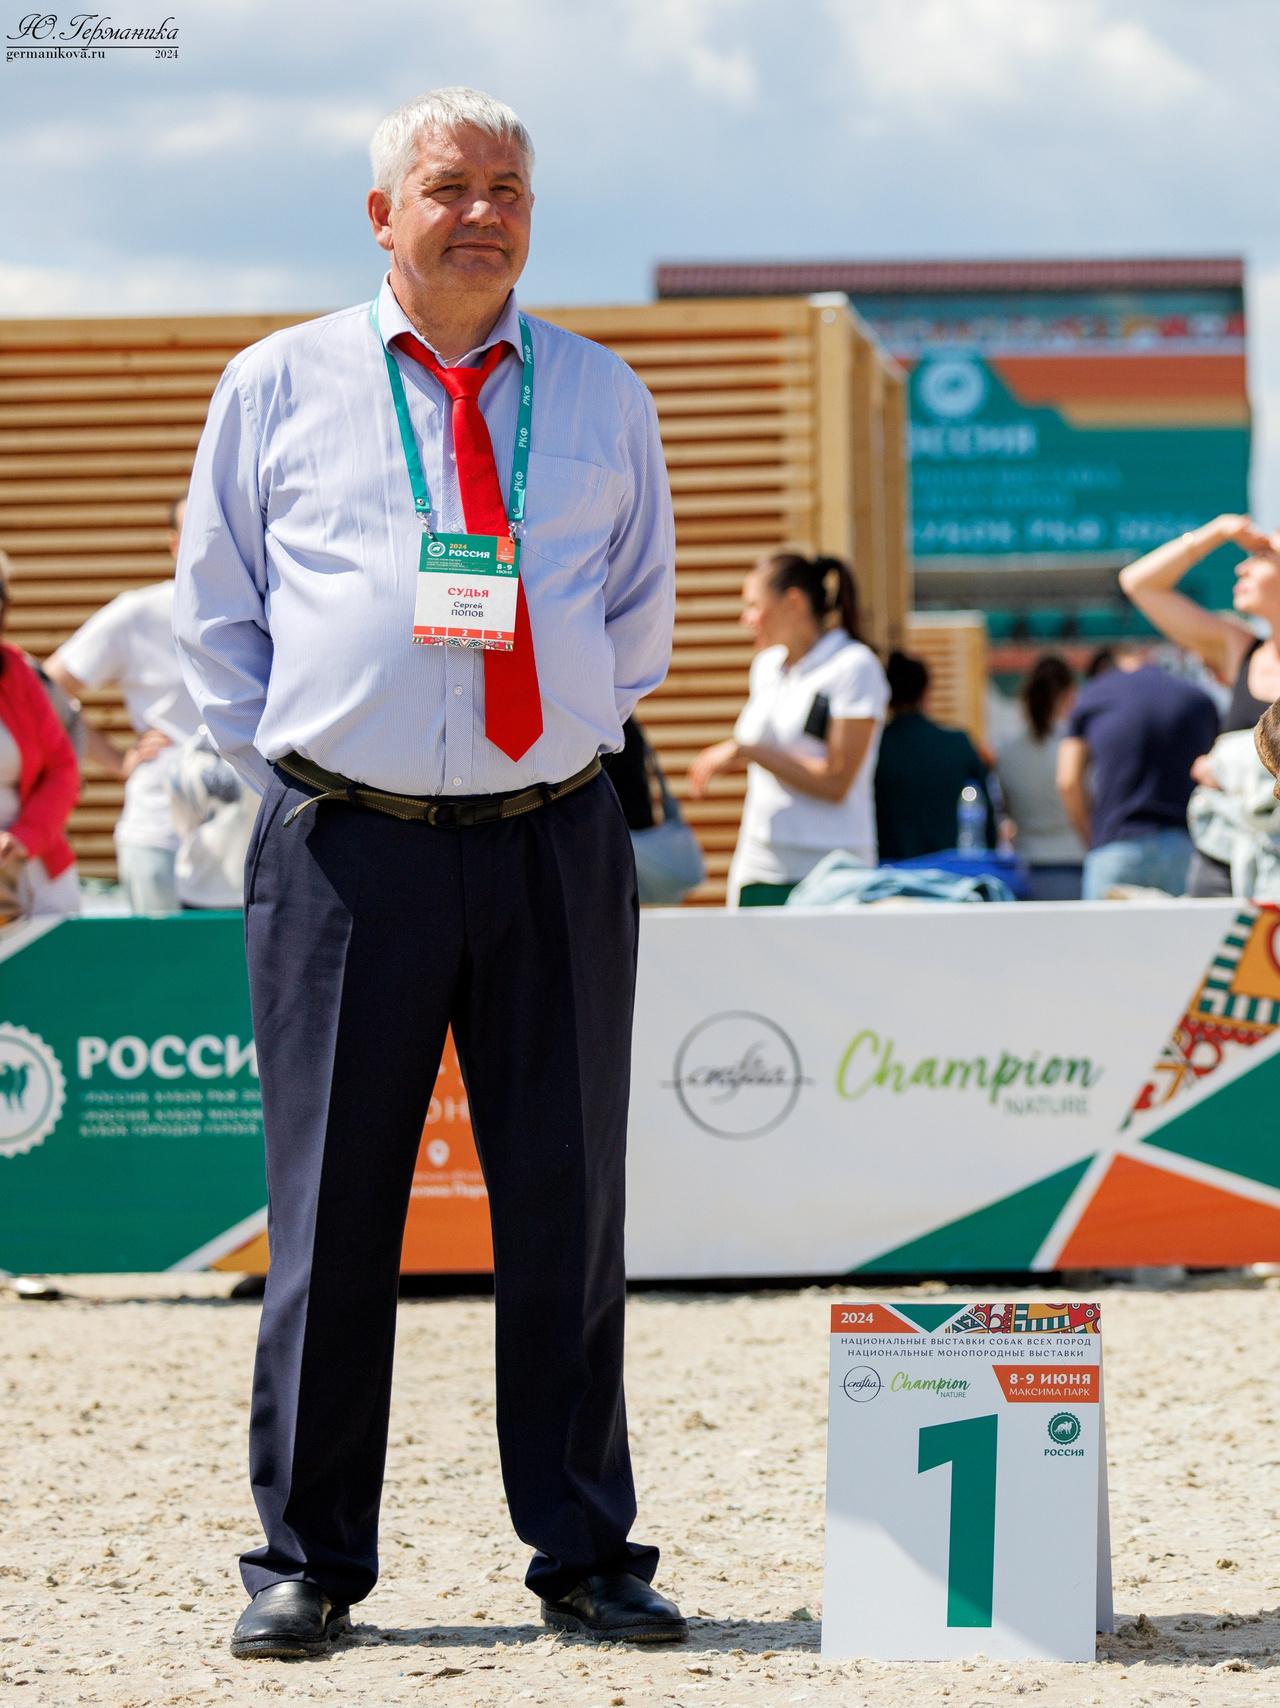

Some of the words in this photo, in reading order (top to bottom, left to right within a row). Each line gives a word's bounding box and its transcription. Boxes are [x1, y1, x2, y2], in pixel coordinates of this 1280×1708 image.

[522, 385, 532, 406] РКФ
[518, 427, 528, 448] РКФ
[513, 471, 524, 492] РКФ
[448, 549, 490, 559] РОССИЯ
[447, 587, 489, 598] СУДЬЯ
[453, 601, 483, 609] Сергей
[451, 609, 484, 618] ПОПОВ
[430, 627, 435, 635] 1
[462, 629, 468, 637] 2
[77, 1034, 260, 1080] РОССИ
[835, 1027, 1104, 1105] Champion
[840, 1312, 874, 1323] 2024
[840, 1337, 927, 1346] НАЦИОНАЛЬНЫЕ
[930, 1337, 985, 1345] ВЫСТАВКИ
[1056, 1338, 1091, 1346] ПОРОД
[847, 1349, 933, 1357] НАЦИОНАЛЬНЫЕ
[937, 1349, 1025, 1358] МОНОПОРОДНЫЕ
[1029, 1349, 1084, 1357] ВЫСТАВКИ
[890, 1371, 971, 1395] Champion
[1009, 1373, 1035, 1385] 8-9
[1040, 1373, 1091, 1385] ИЮНЯ
[1009, 1388, 1062, 1396] МАКСИМА
[1064, 1388, 1090, 1396] ПАРК
[1044, 1448, 1084, 1457] РОССИЯ
[918, 1413, 998, 1628] 1
